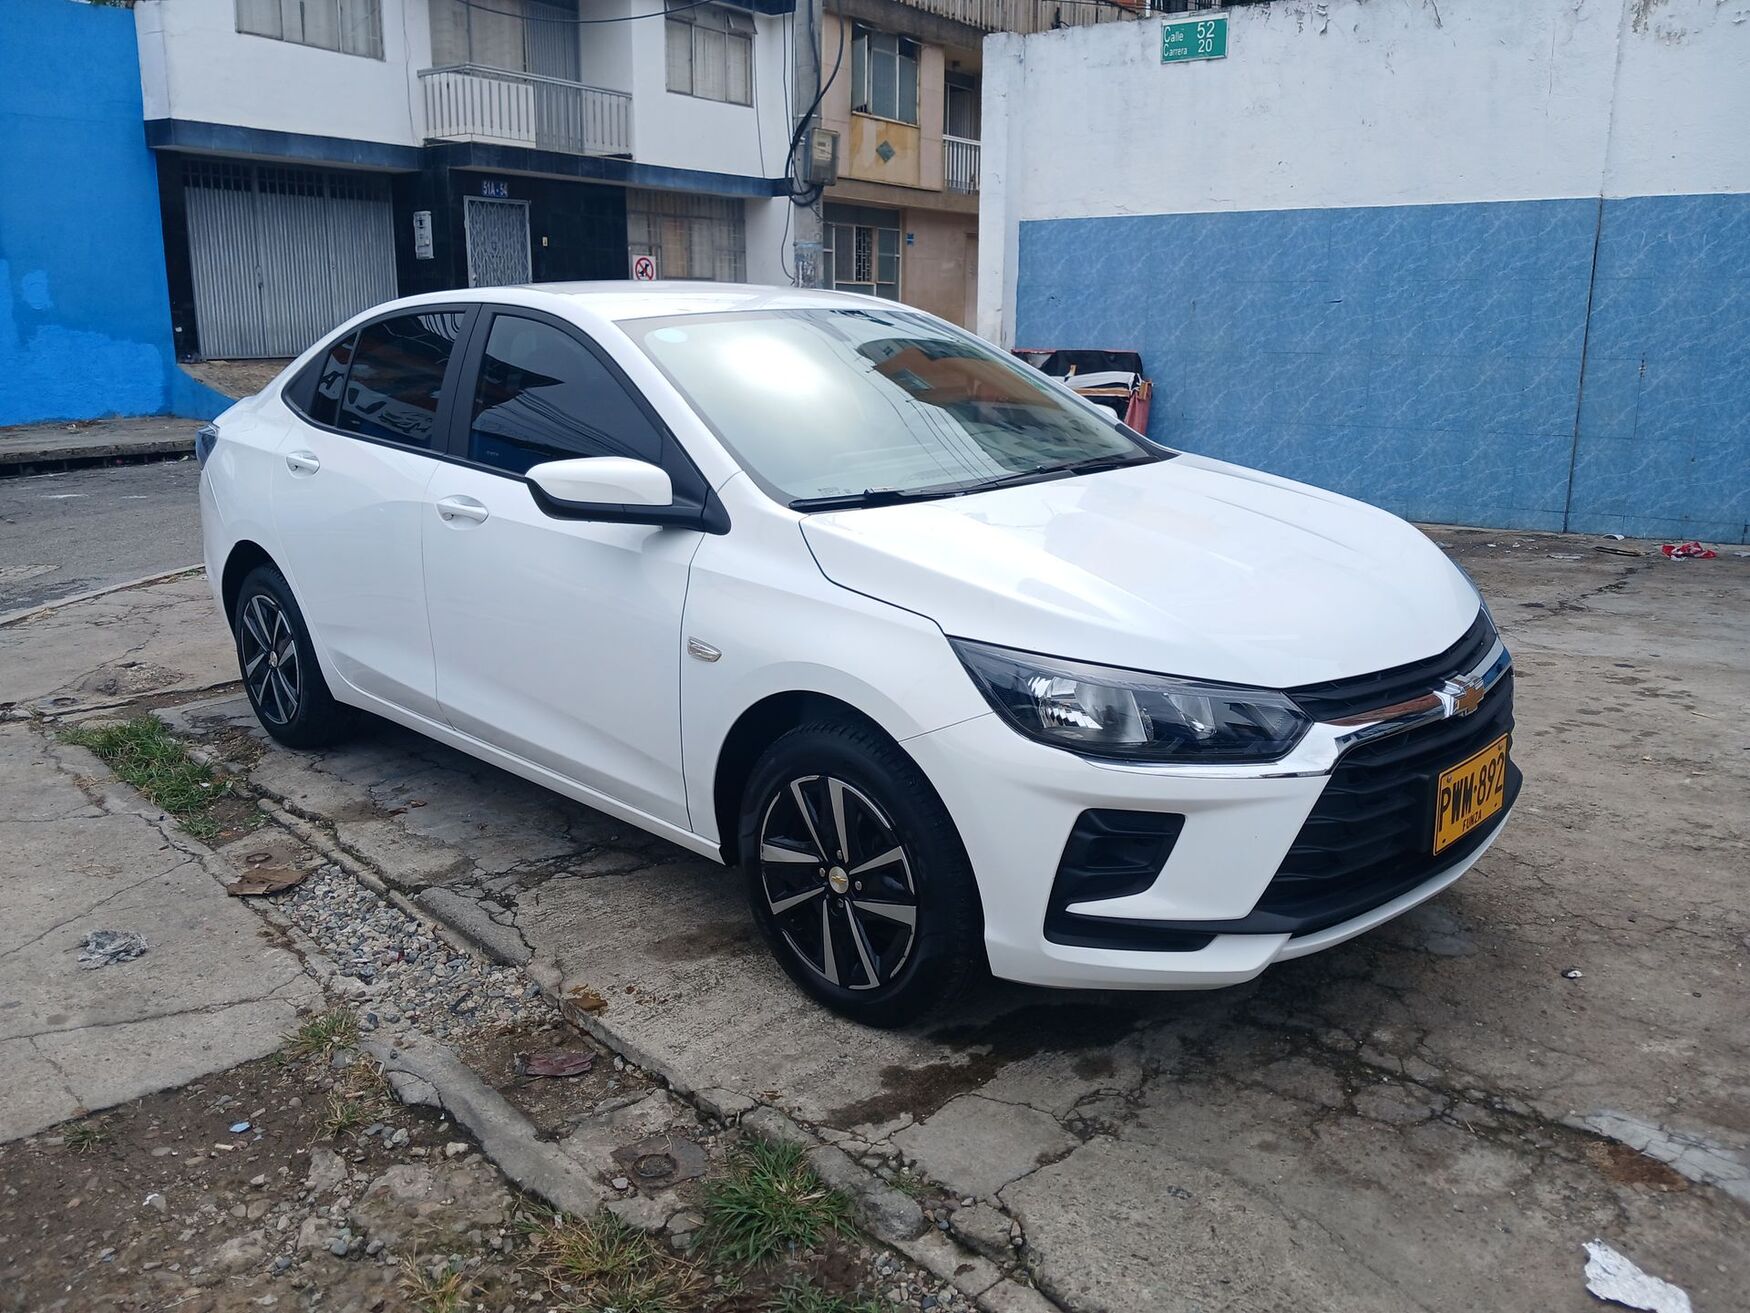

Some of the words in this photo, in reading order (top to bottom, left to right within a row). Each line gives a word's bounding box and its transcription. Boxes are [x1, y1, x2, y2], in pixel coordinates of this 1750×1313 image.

[1164, 26, 1184, 43] Calle
[1197, 21, 1215, 39] 52
[1163, 43, 1188, 57] Carrera
[1198, 38, 1213, 53] 20
[1462, 809, 1482, 832] FUNZA
